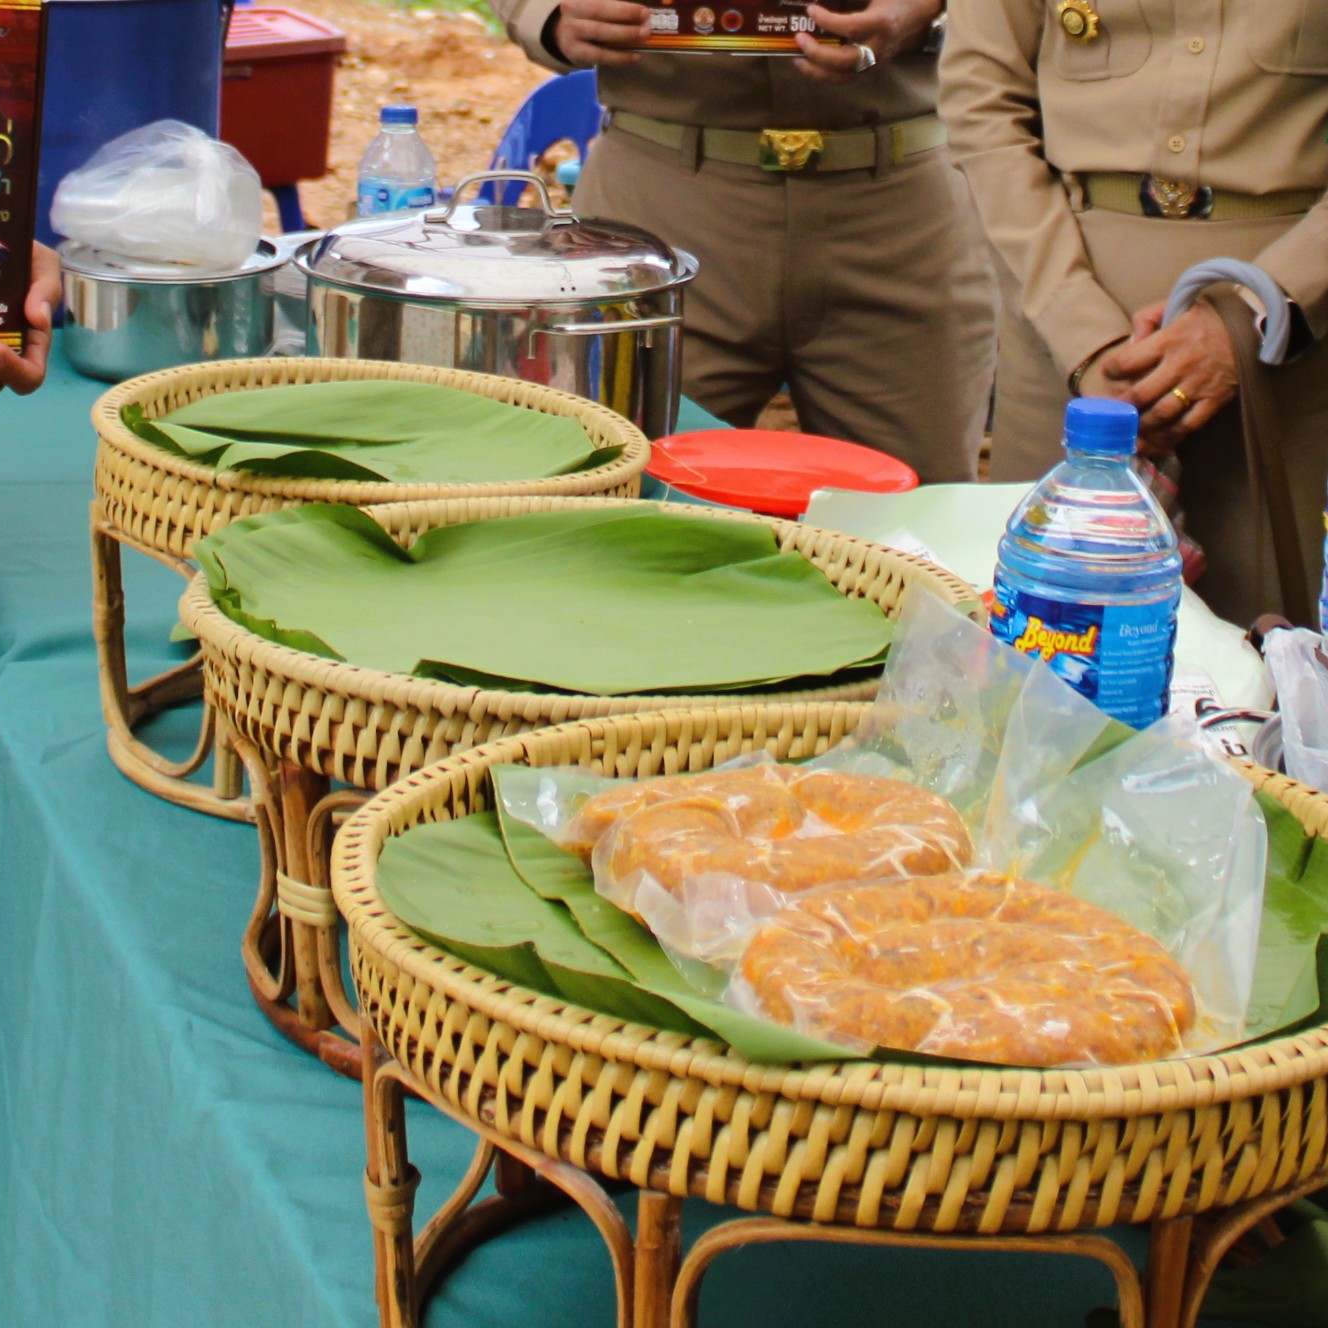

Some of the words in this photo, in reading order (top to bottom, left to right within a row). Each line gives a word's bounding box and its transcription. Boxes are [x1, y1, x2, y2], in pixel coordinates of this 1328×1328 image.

[791, 16, 816, 32] 500
[1014, 615, 1100, 663] Beyond
[1119, 619, 1159, 639] Beyond
